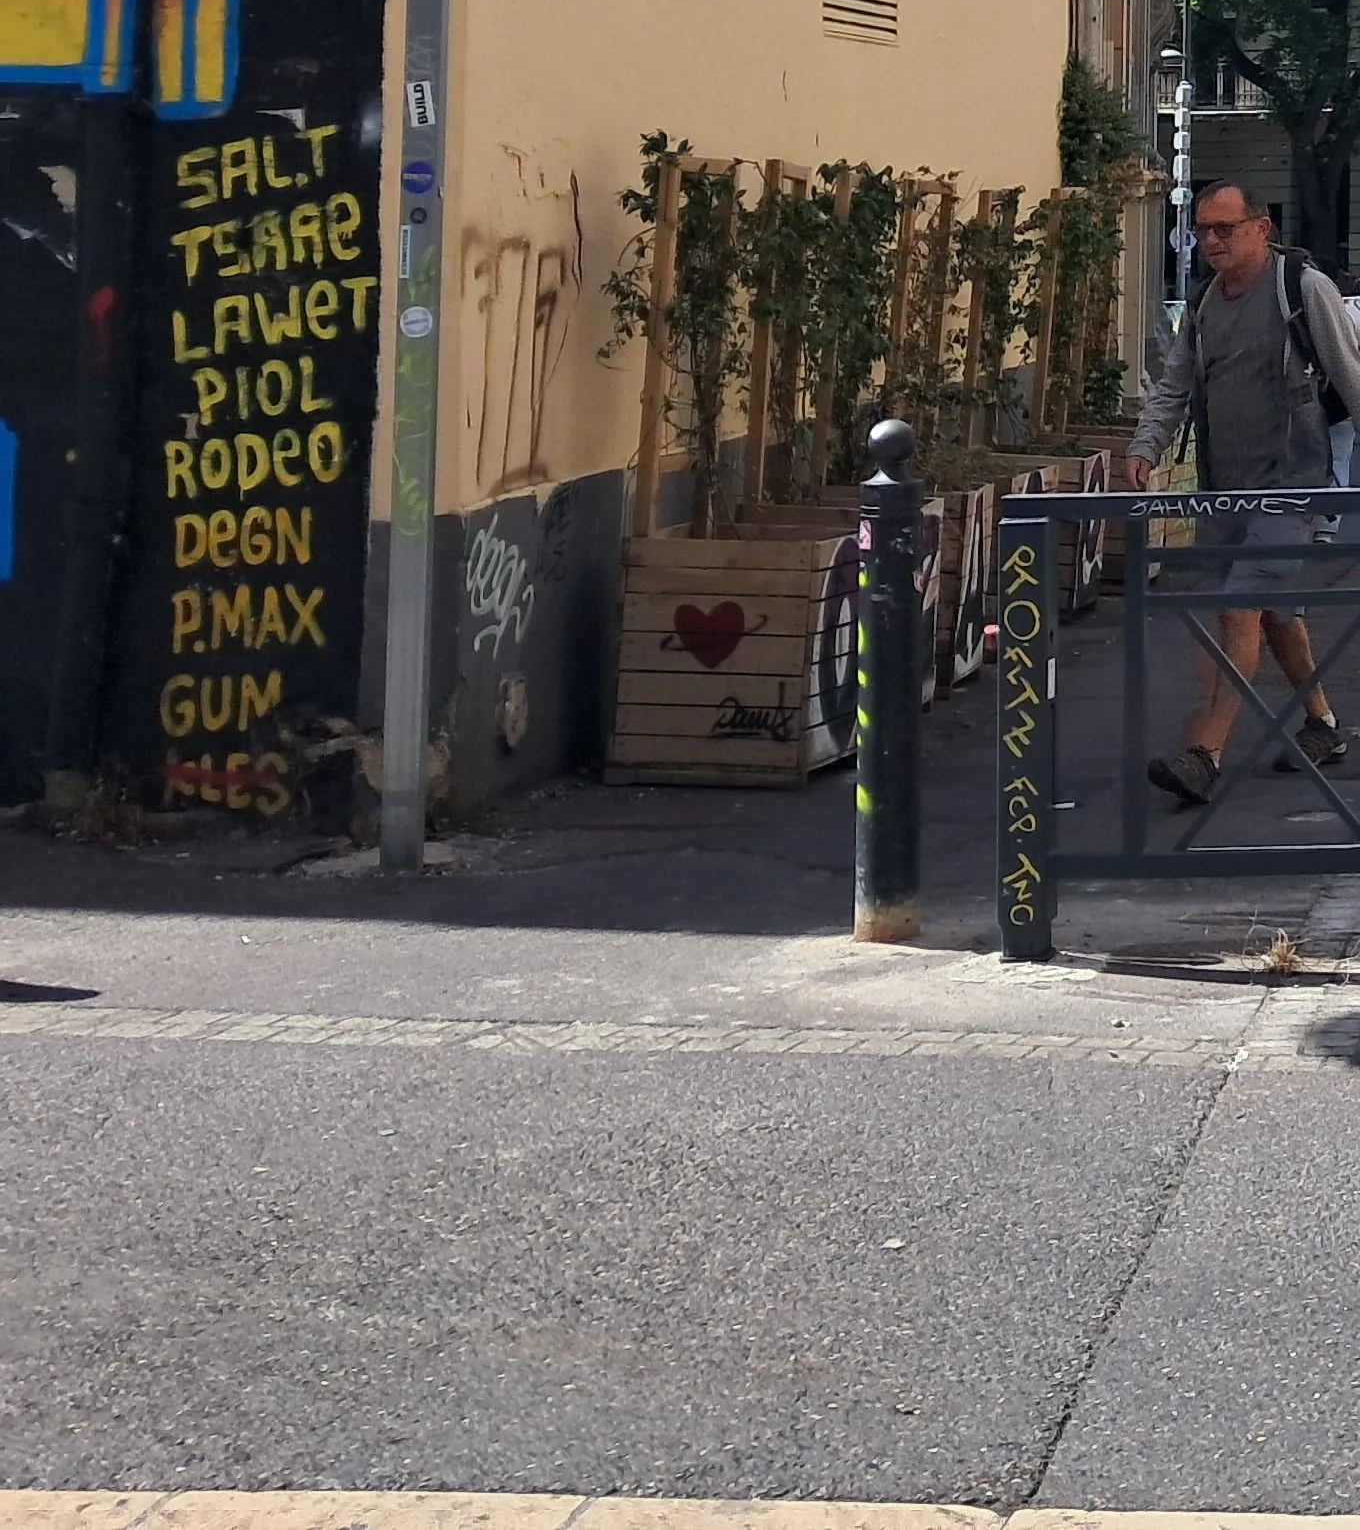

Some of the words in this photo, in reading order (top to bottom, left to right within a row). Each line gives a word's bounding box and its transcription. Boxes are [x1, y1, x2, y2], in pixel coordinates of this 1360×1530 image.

[413, 83, 431, 125] BUILD
[192, 357, 334, 425] PIOL
[159, 670, 284, 738] GUM
